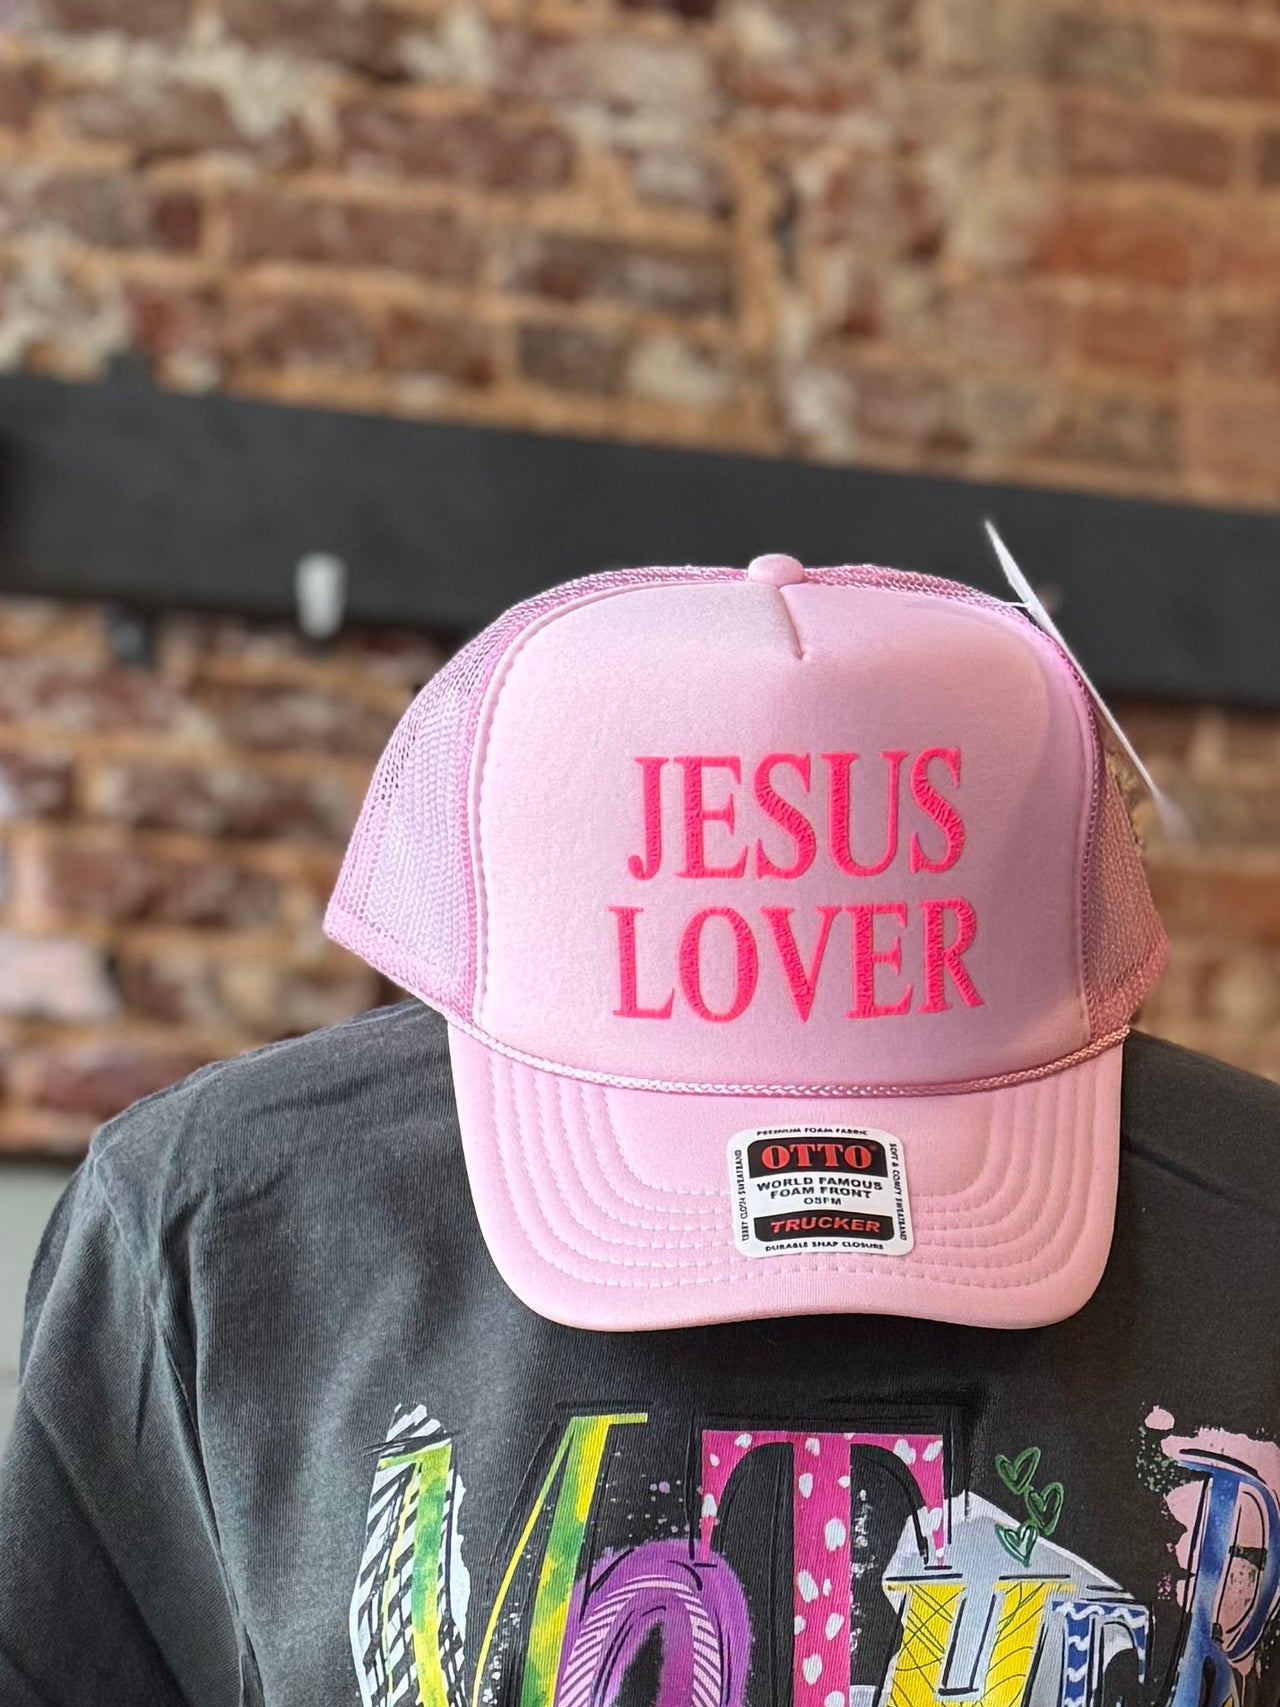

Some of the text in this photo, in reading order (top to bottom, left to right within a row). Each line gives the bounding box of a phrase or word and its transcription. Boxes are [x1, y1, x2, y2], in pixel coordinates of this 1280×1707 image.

[626, 746, 967, 881] JESUS
[607, 896, 986, 1024] LOVER
[762, 1144, 872, 1170] OTTO
[757, 1177, 884, 1192] WORLD FAMOUS
[771, 1187, 872, 1200] FOAM FRONT
[804, 1197, 842, 1206] OSFM
[771, 1217, 881, 1234] TRUCKER
[765, 1241, 809, 1252] DURABLE
